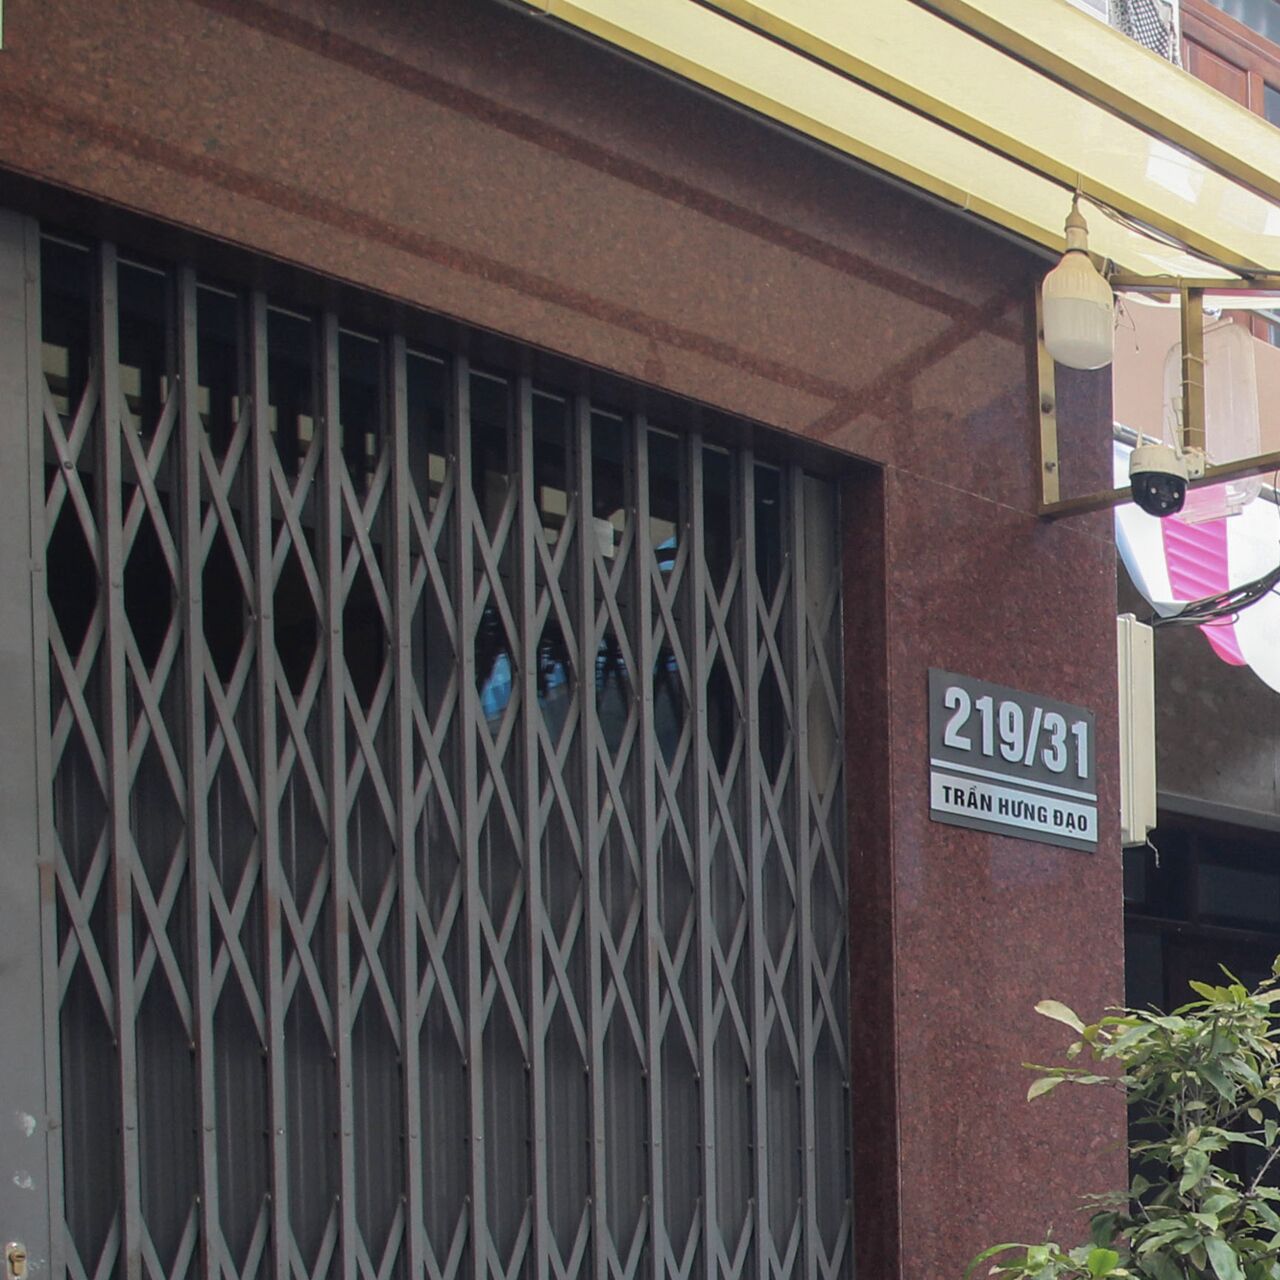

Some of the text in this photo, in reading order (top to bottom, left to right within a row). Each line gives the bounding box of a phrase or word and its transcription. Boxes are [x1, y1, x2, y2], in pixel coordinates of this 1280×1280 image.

[944, 687, 1088, 778] 219/31
[943, 786, 1087, 833] TRẦN HƯNG ĐẠO
